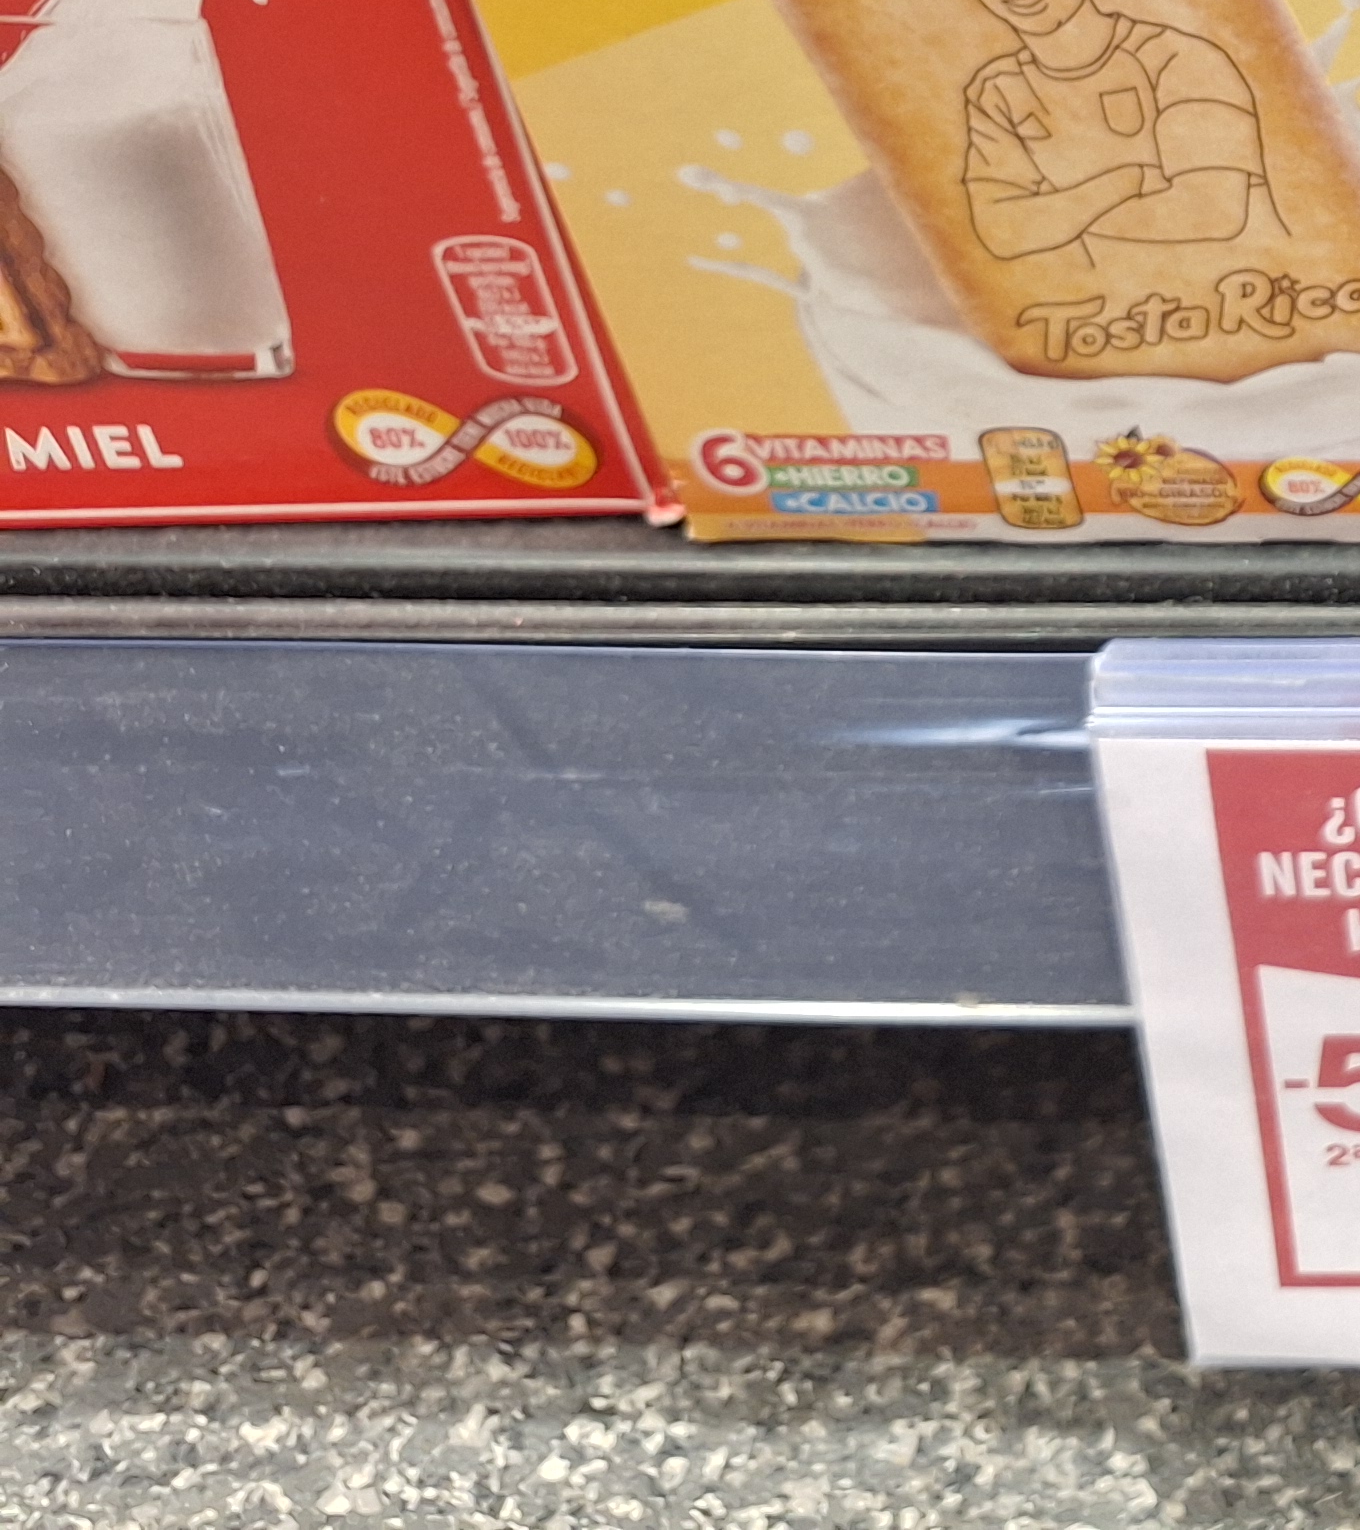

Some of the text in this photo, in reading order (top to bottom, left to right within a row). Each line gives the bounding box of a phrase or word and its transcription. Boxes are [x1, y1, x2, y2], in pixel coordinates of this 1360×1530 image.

[1017, 290, 1210, 362] Tosta
[4, 424, 184, 471] MIEL
[369, 427, 425, 450] 80%
[504, 428, 573, 451] 100%
[700, 433, 947, 489] 6 VITAMINAS
